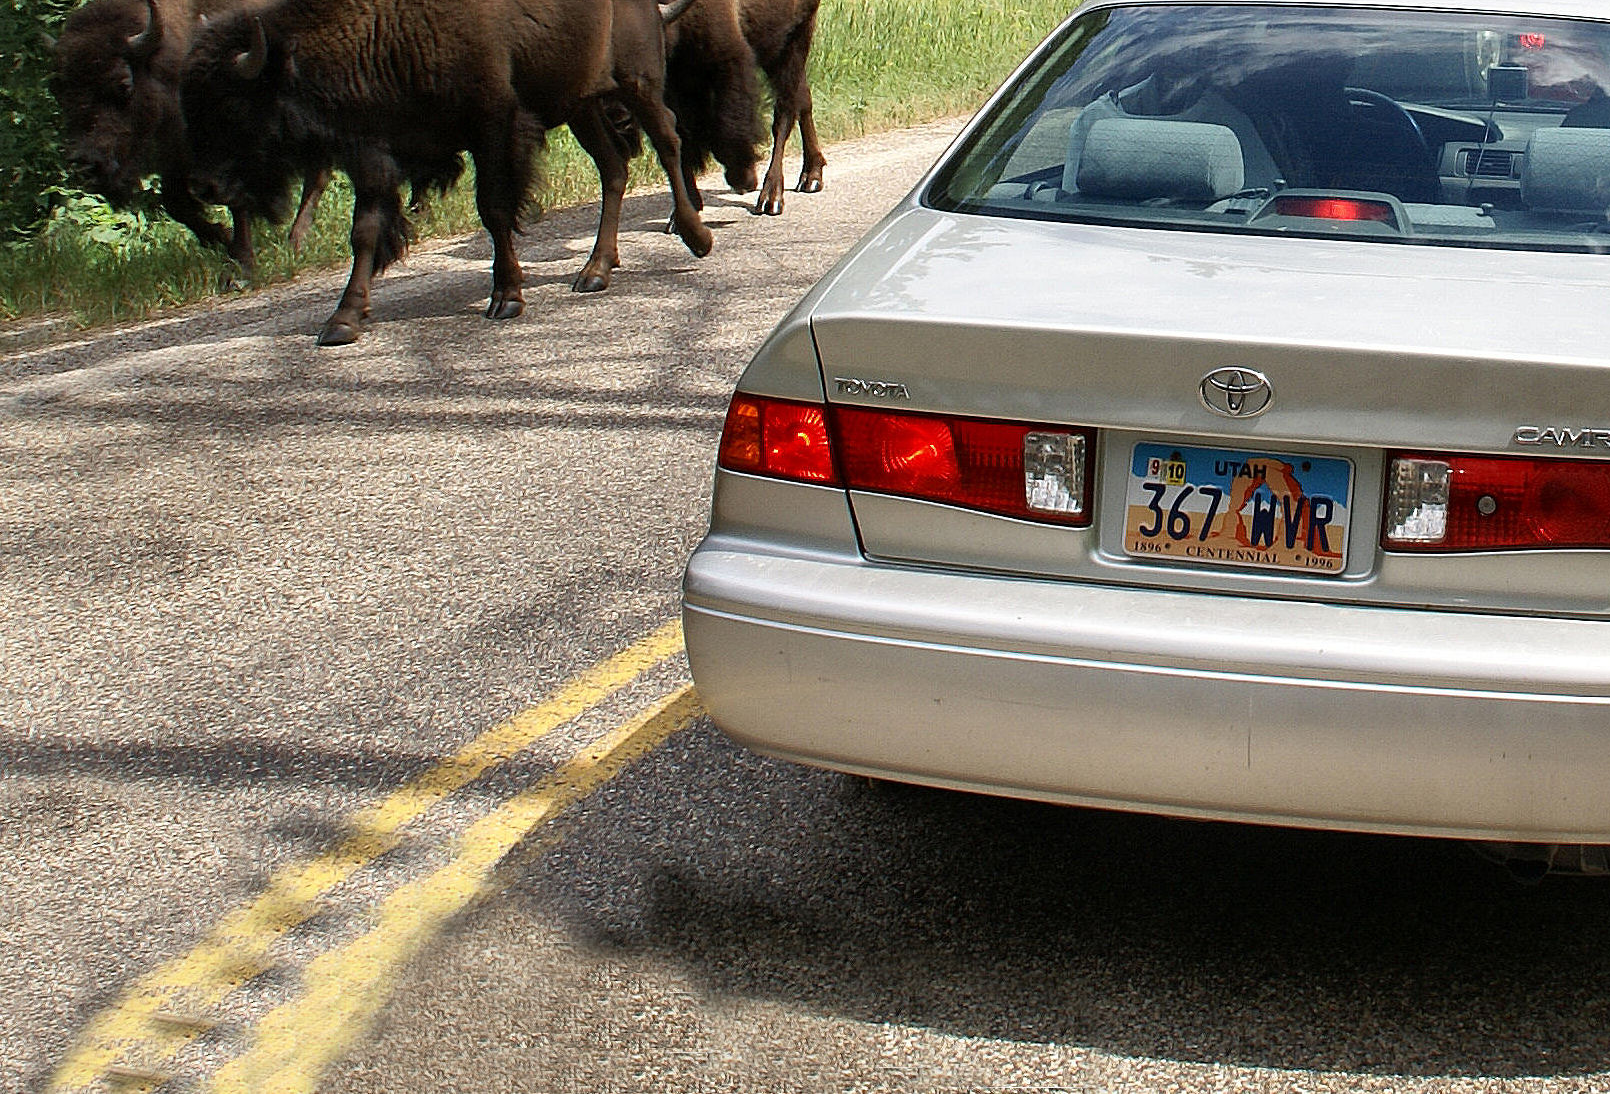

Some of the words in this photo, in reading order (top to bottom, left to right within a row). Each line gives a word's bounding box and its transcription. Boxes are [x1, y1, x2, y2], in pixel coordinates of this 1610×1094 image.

[834, 377, 911, 400] TOYOTA
[1151, 459, 1160, 475] 9
[1168, 463, 1185, 480] 10
[1214, 460, 1267, 479] UTAH
[1139, 482, 1223, 542] 367
[1250, 492, 1334, 553] WVR
[1134, 540, 1162, 552] 1896
[1185, 546, 1280, 564] CENTENNIAL
[1304, 556, 1334, 569] 1996
